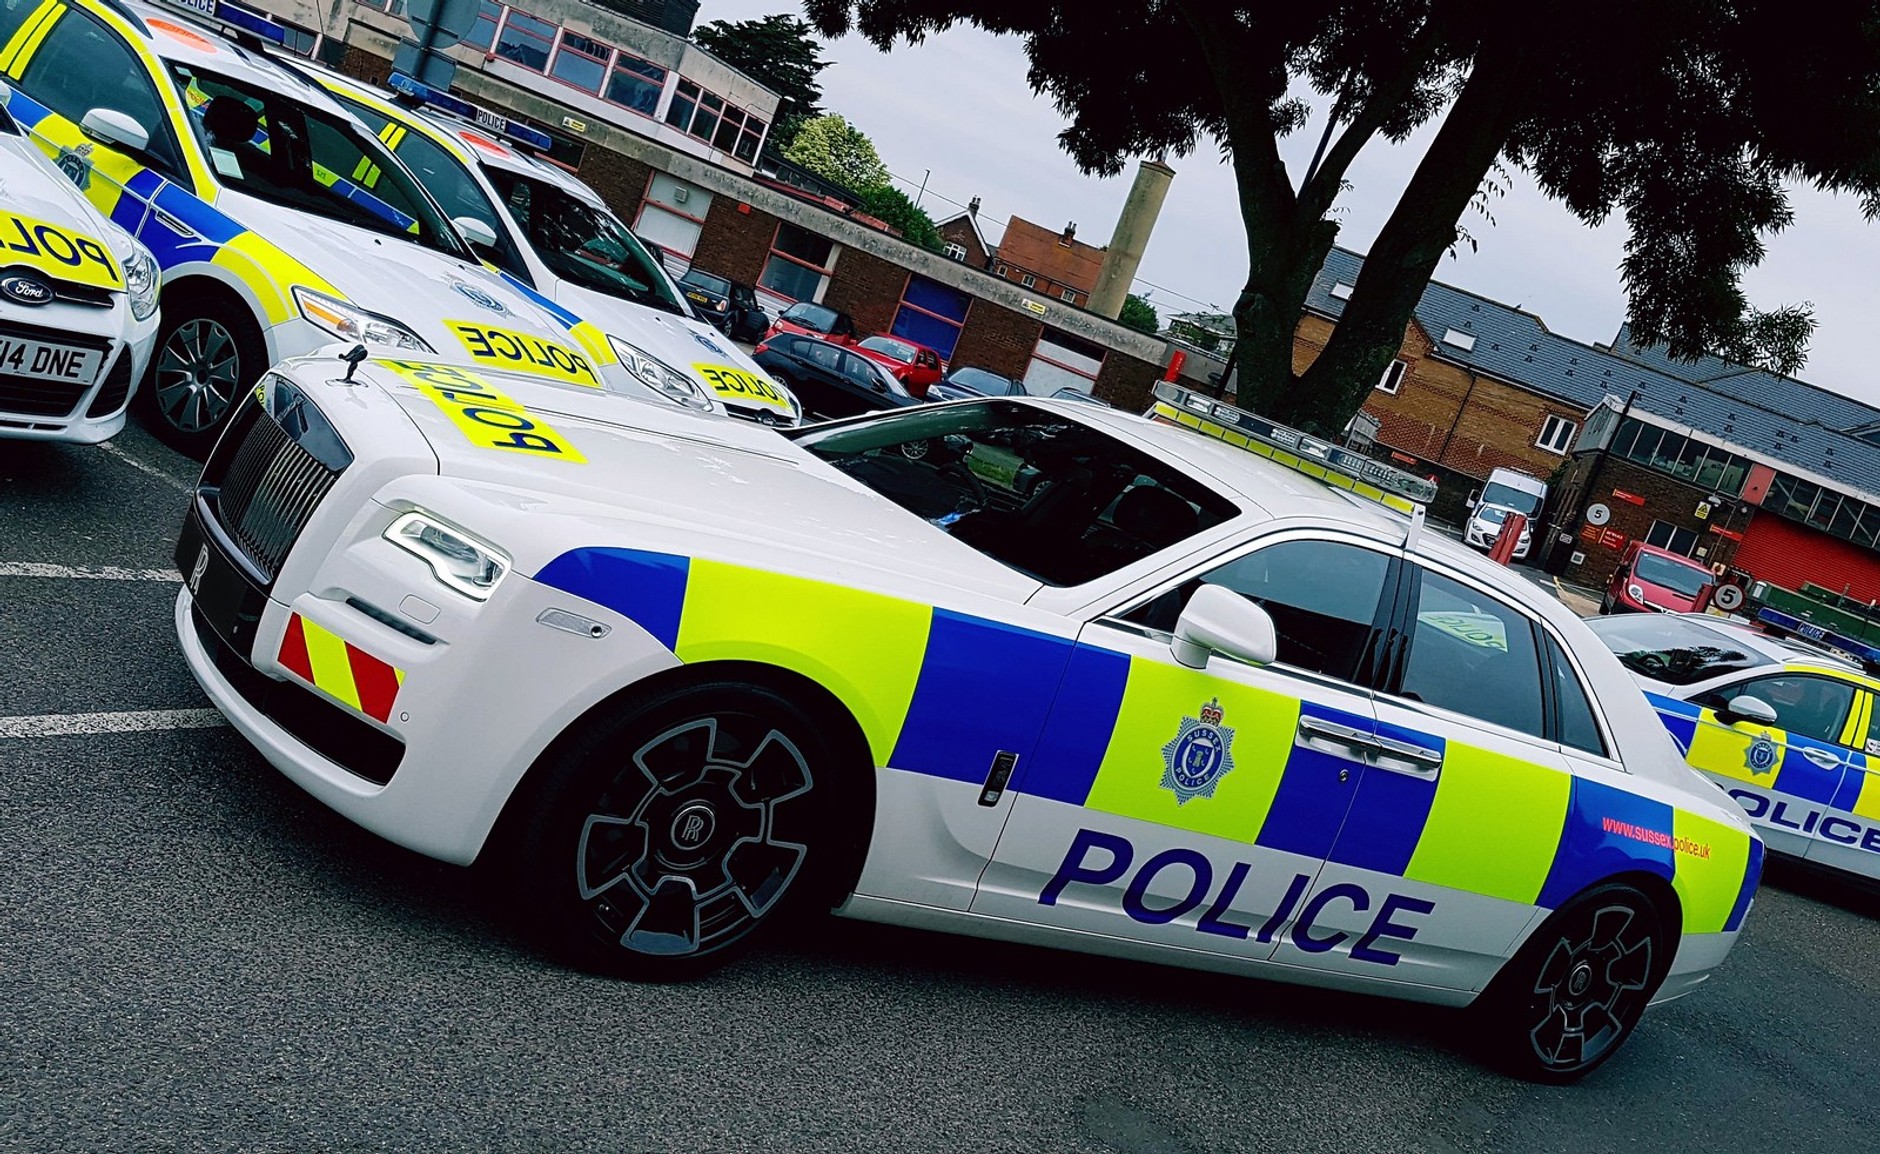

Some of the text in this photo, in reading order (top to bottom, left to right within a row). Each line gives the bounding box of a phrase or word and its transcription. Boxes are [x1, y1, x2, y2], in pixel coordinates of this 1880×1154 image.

[477, 110, 506, 132] POLICE
[15, 282, 43, 298] Ford
[0, 340, 86, 378] 14 DNE
[1594, 509, 1604, 519] 5
[1720, 587, 1737, 605] 5
[1187, 729, 1221, 752] SUSSEX
[1175, 765, 1211, 786] POLICE
[1718, 784, 1880, 853] OLICE
[1602, 816, 1711, 860] www.sussex.police.uk
[1037, 828, 1437, 966] POLICE
